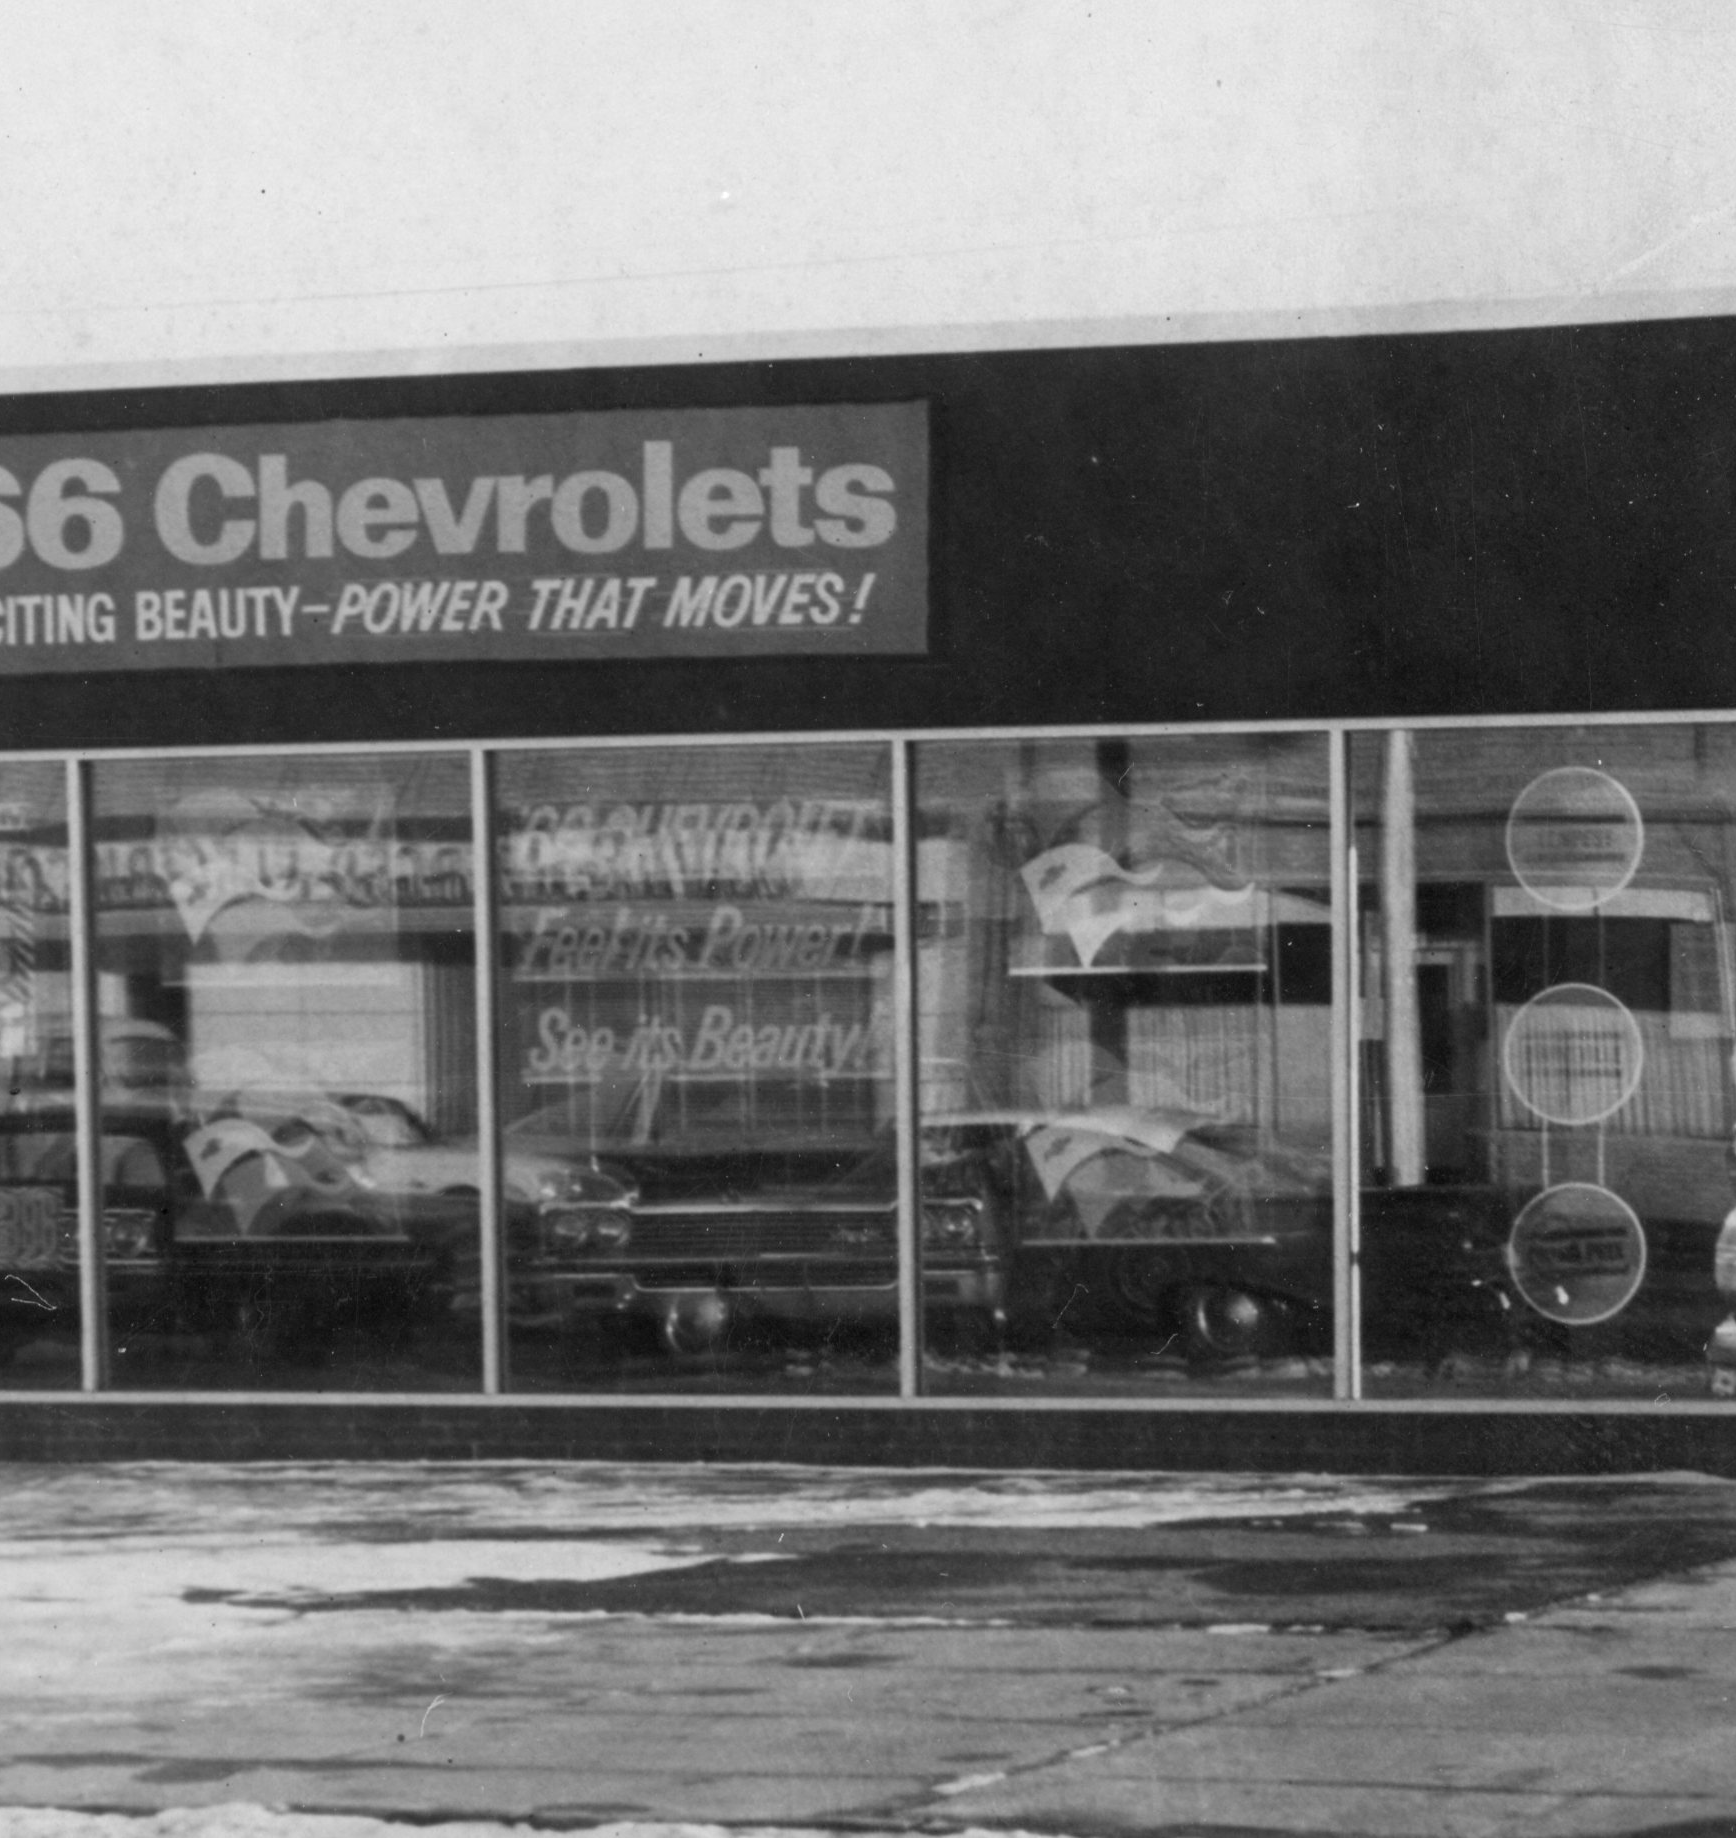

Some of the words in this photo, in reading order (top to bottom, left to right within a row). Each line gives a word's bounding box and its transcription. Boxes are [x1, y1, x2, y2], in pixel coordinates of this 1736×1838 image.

[154, 440, 897, 565] Chevrolets
[527, 576, 658, 631] THAT
[662, 570, 877, 630] MOVES!
[519, 904, 633, 969] Feel
[526, 1005, 616, 1072] See
